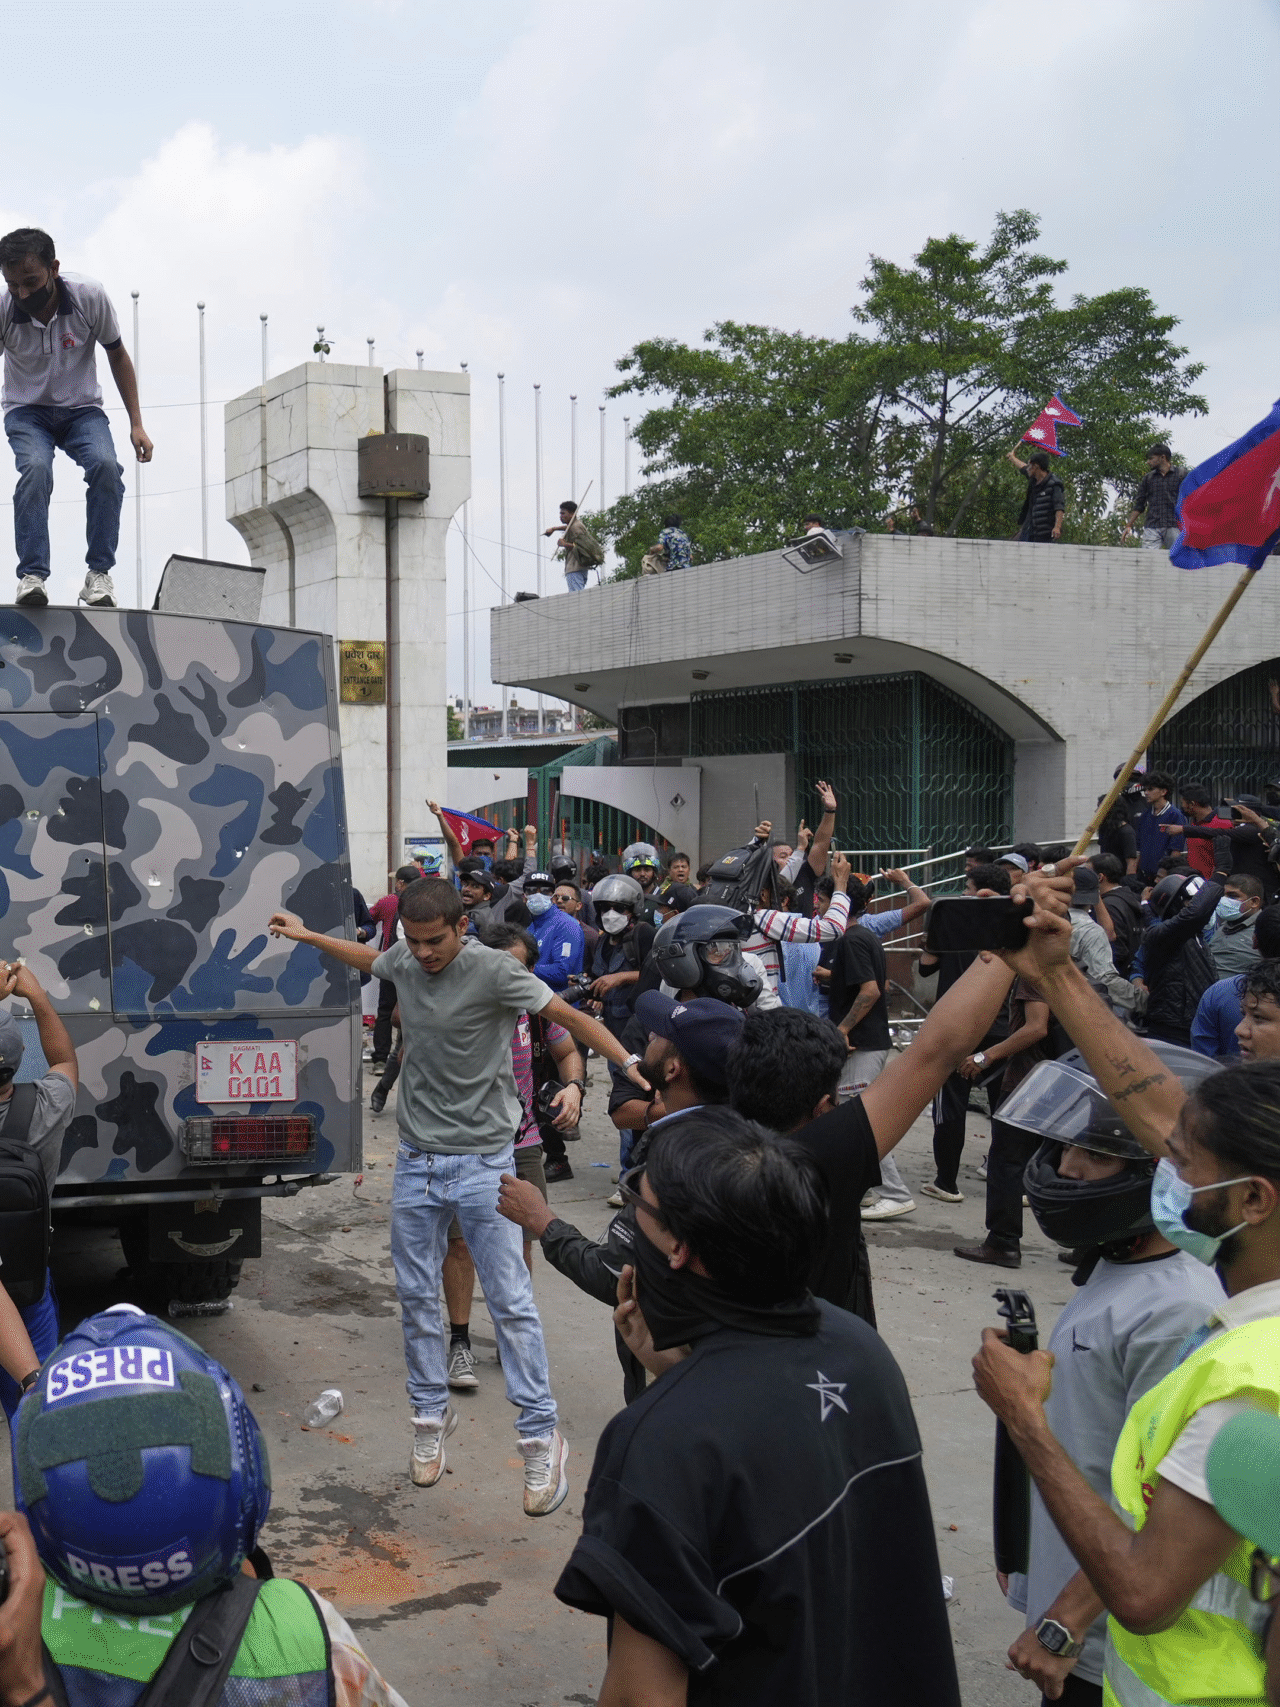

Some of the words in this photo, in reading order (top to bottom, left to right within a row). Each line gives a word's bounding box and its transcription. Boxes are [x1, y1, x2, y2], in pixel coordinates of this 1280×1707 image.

[343, 676, 370, 684] ENTRANCE
[531, 873, 549, 881] OBEY
[229, 1051, 243, 1074] K
[254, 1051, 282, 1073] AA
[228, 1075, 283, 1098] 0101
[50, 1347, 170, 1397] PRESS
[66, 1550, 193, 1591] PRESS
